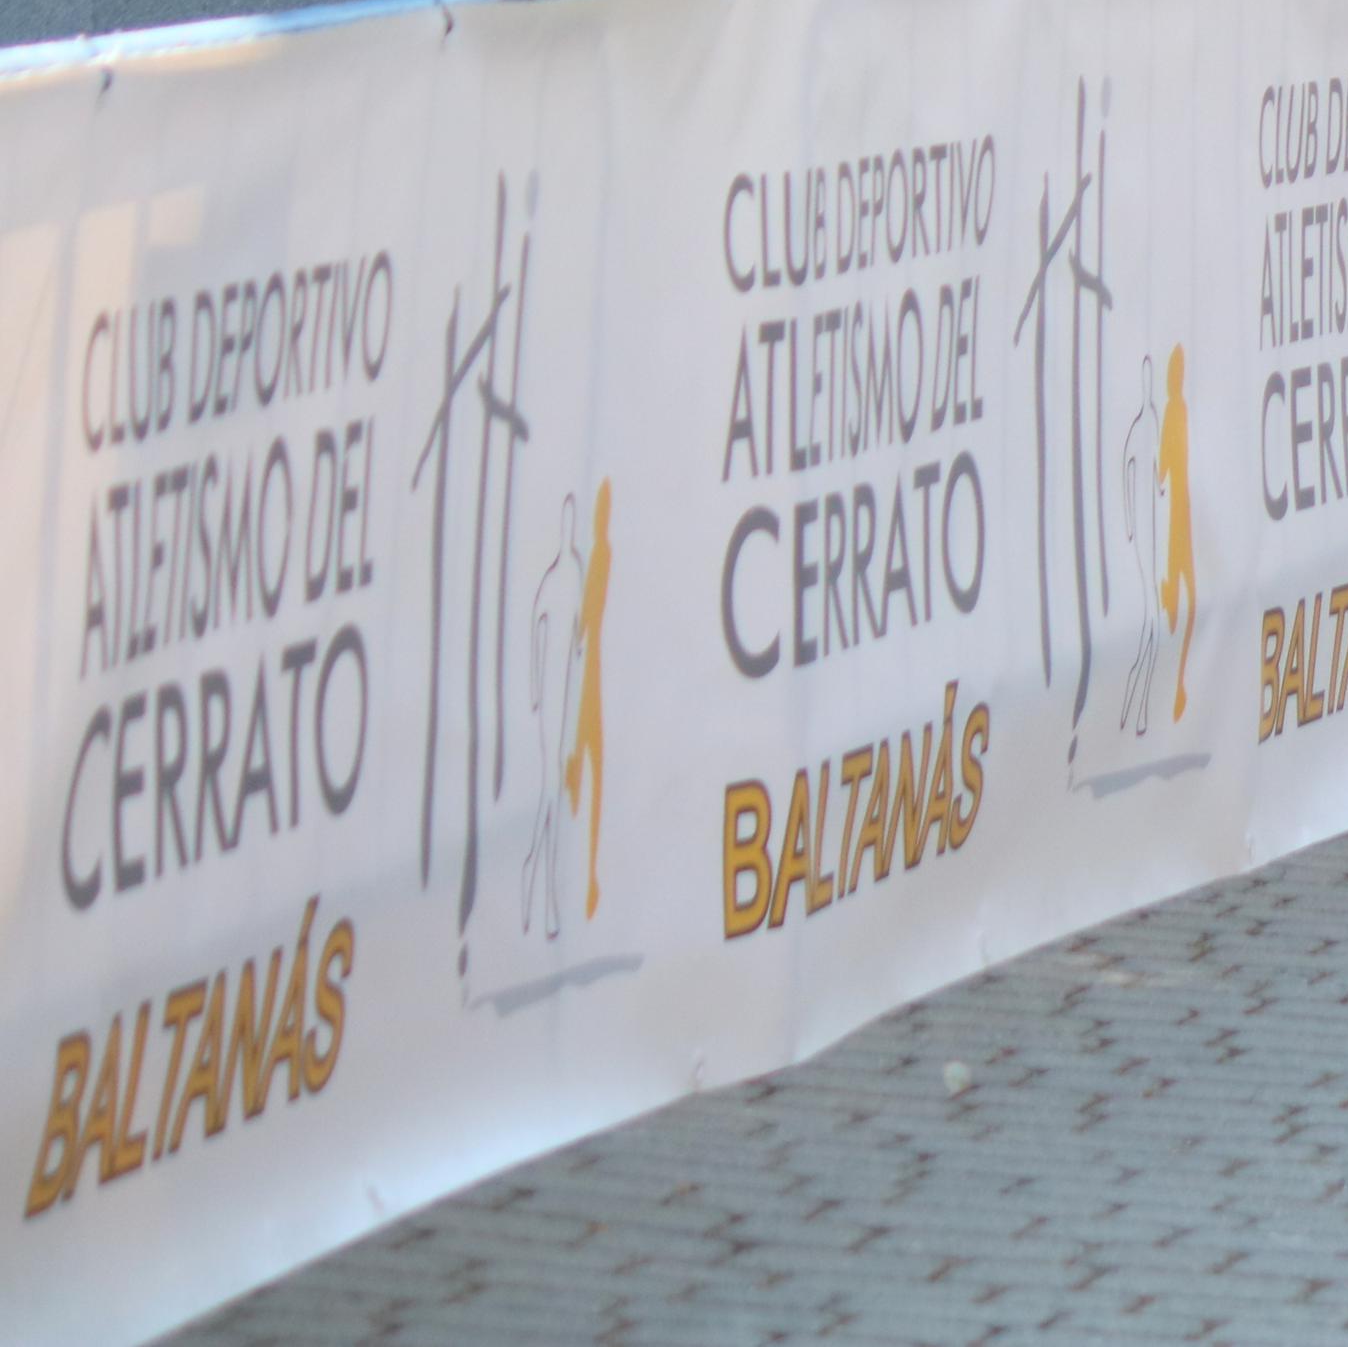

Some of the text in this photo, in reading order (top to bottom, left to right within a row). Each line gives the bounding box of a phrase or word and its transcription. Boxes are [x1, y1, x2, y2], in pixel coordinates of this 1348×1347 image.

[724, 133, 997, 292] CLUB DEPORTIVO
[1258, 80, 1319, 186] CLUB
[82, 249, 395, 453] CLUB DEPORTIVO
[723, 276, 984, 483] ATLETISMO DEL
[78, 416, 377, 677] ATLETISMO DEL
[720, 451, 987, 680] CERRATO
[61, 622, 371, 915] CERRATO
[723, 681, 990, 939] BALTANÁS
[26, 895, 356, 1219] BALTANÁS
